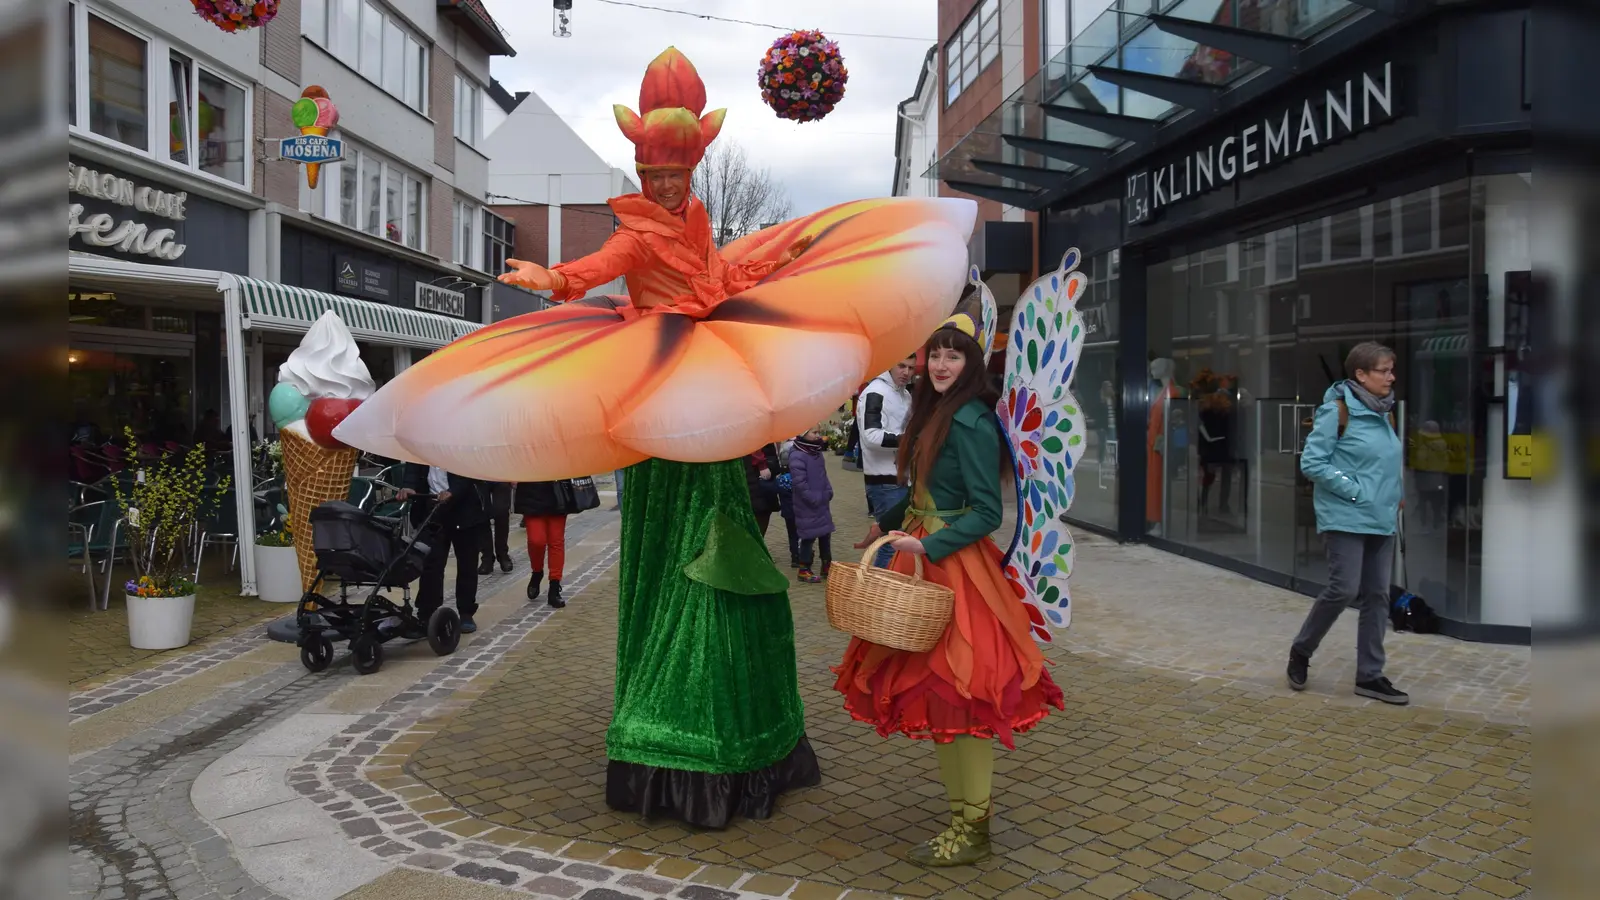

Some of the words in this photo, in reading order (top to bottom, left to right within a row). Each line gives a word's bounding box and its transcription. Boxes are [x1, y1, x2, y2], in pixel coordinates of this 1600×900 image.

[1153, 61, 1392, 209] KLINGEMANN
[283, 144, 339, 158] MOSENA
[1127, 174, 1137, 198] 17
[419, 286, 463, 316] HEIMISCH
